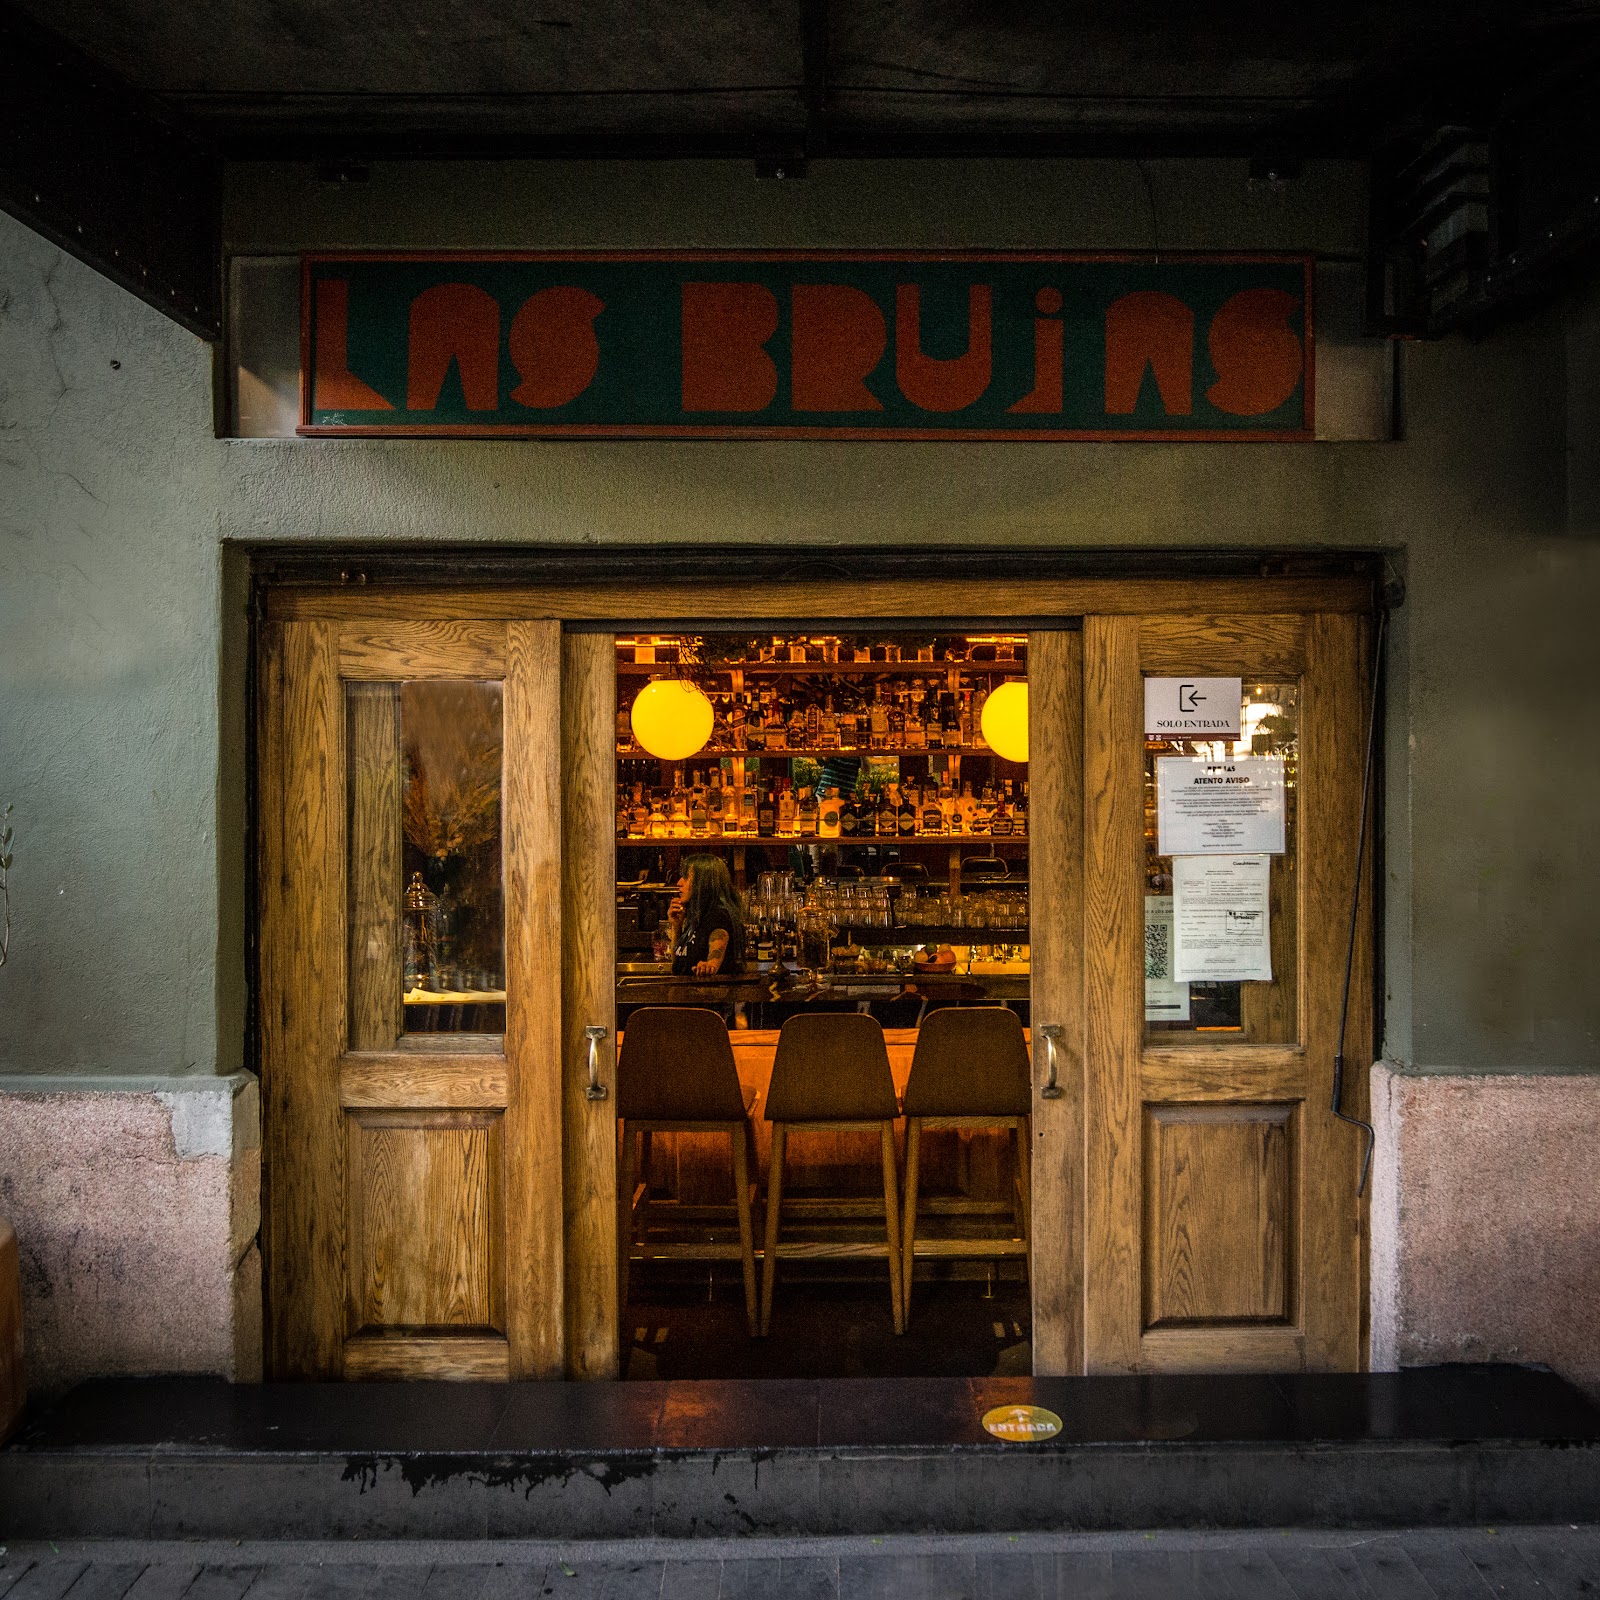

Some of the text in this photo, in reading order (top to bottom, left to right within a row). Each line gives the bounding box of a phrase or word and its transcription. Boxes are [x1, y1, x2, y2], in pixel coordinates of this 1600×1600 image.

[314, 279, 606, 411] LAS
[1156, 719, 1230, 728] SOLO ENTRADA
[1193, 776, 1250, 785] ATENTO AVISO
[988, 1422, 1057, 1433] ENTRADA
